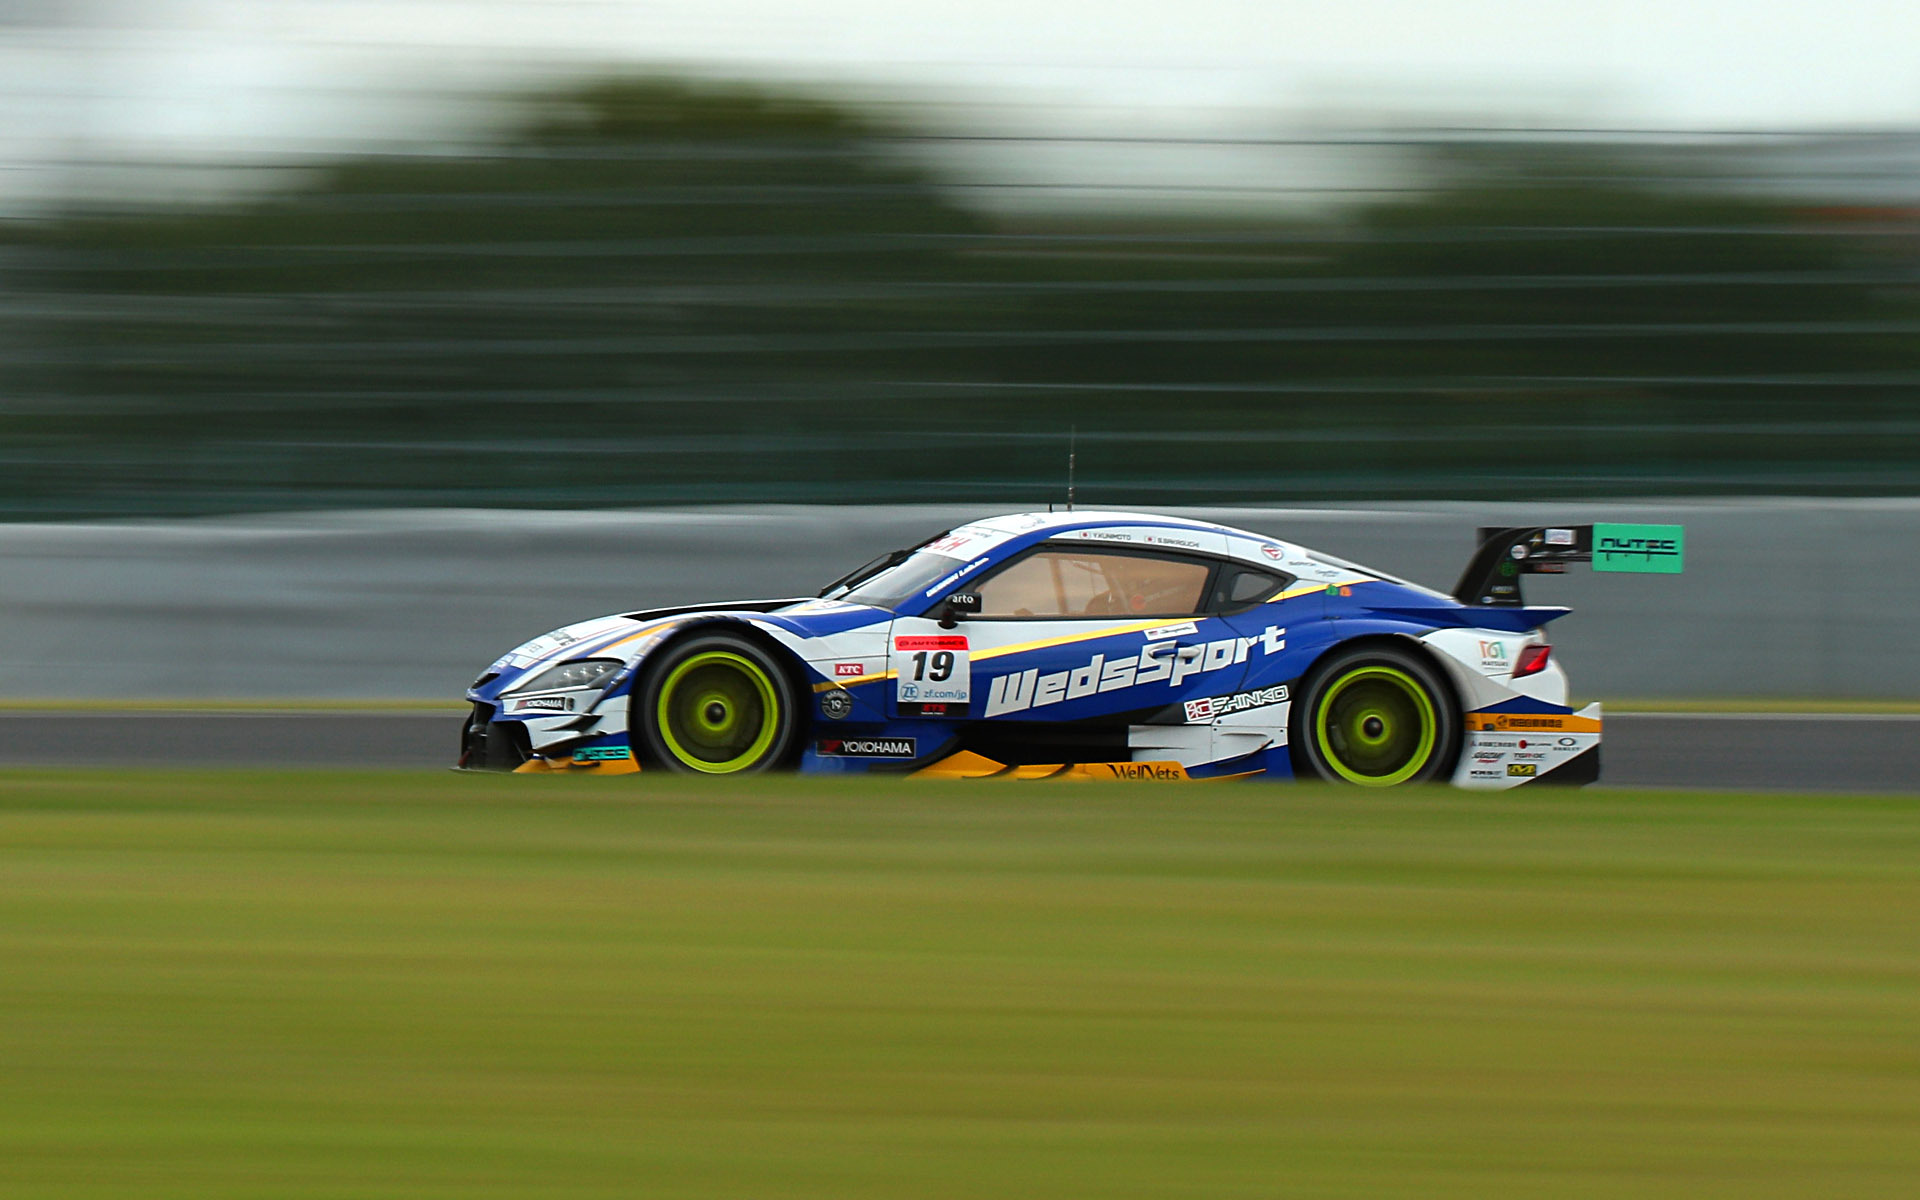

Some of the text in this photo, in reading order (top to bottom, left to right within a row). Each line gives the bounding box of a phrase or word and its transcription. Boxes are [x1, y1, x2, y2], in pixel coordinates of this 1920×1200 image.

[952, 595, 974, 603] arto
[838, 665, 861, 674] KTC
[912, 651, 954, 682] 19
[984, 625, 1285, 718] WedsSport
[902, 687, 917, 698] ZF
[924, 689, 967, 699] zf.com/jp
[1211, 684, 1290, 712] SHINKO
[831, 700, 841, 710] 19
[842, 741, 912, 754] YOKOHAMA
